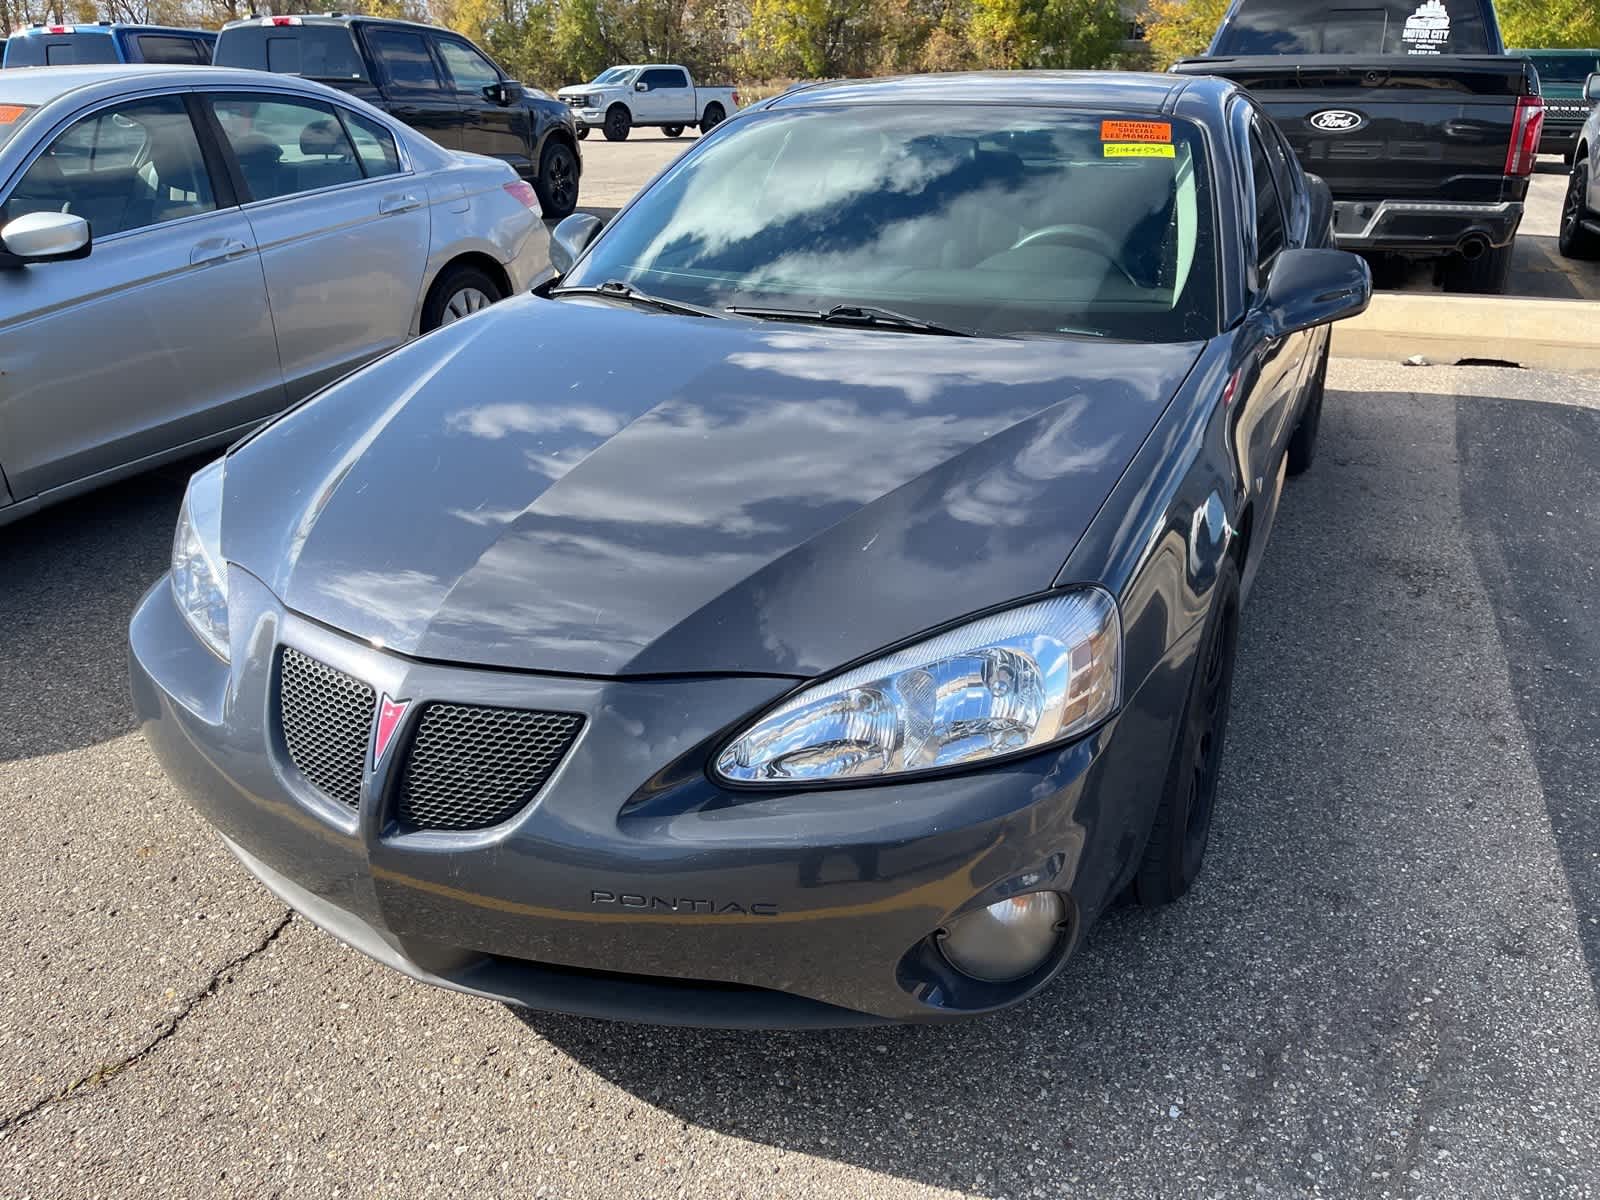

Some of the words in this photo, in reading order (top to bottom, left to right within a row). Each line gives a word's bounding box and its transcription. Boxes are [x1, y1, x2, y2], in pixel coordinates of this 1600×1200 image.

[1402, 28, 1430, 39] MOTOR
[1430, 29, 1450, 40] CITY
[1318, 112, 1353, 128] Ford
[1118, 127, 1153, 135] SPECIAL
[591, 889, 780, 917] PONTIAC
